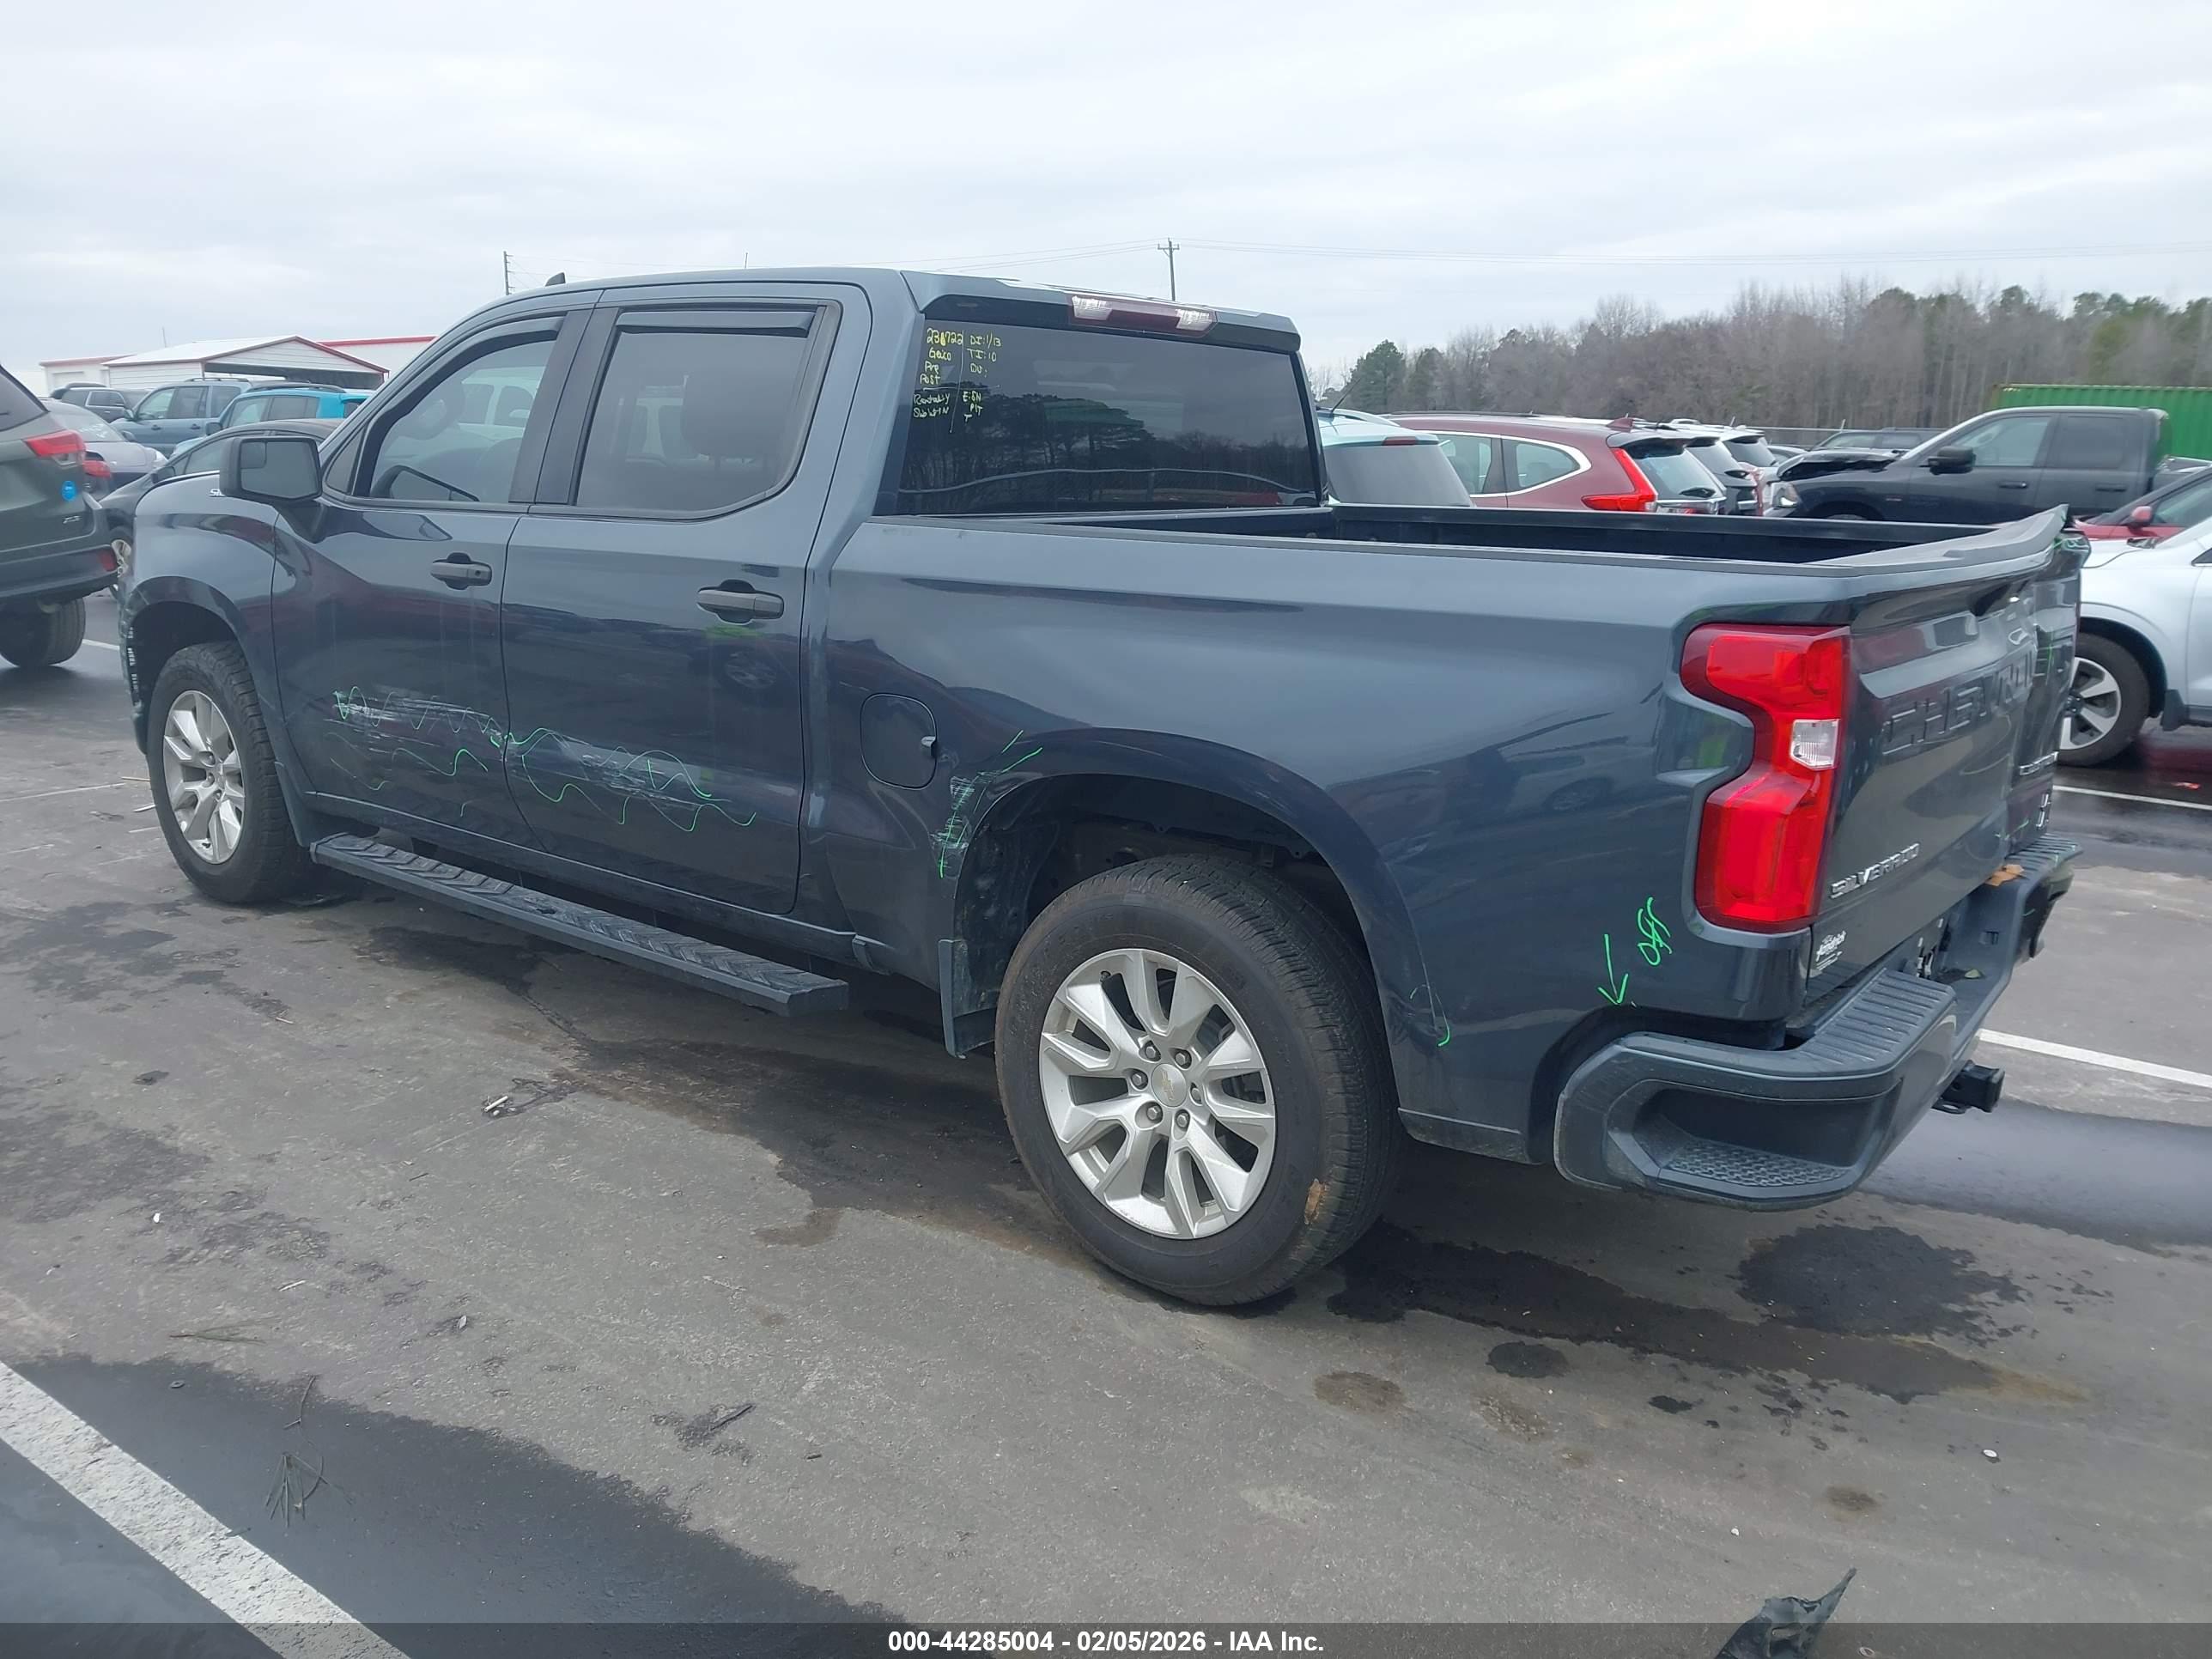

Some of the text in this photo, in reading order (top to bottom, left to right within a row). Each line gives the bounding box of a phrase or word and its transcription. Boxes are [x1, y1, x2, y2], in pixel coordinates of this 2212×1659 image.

[929, 347, 951, 361] Geico
[926, 361, 939, 374] Pre
[921, 374, 941, 385] Post
[1830, 842, 1921, 899] SILVERADO
